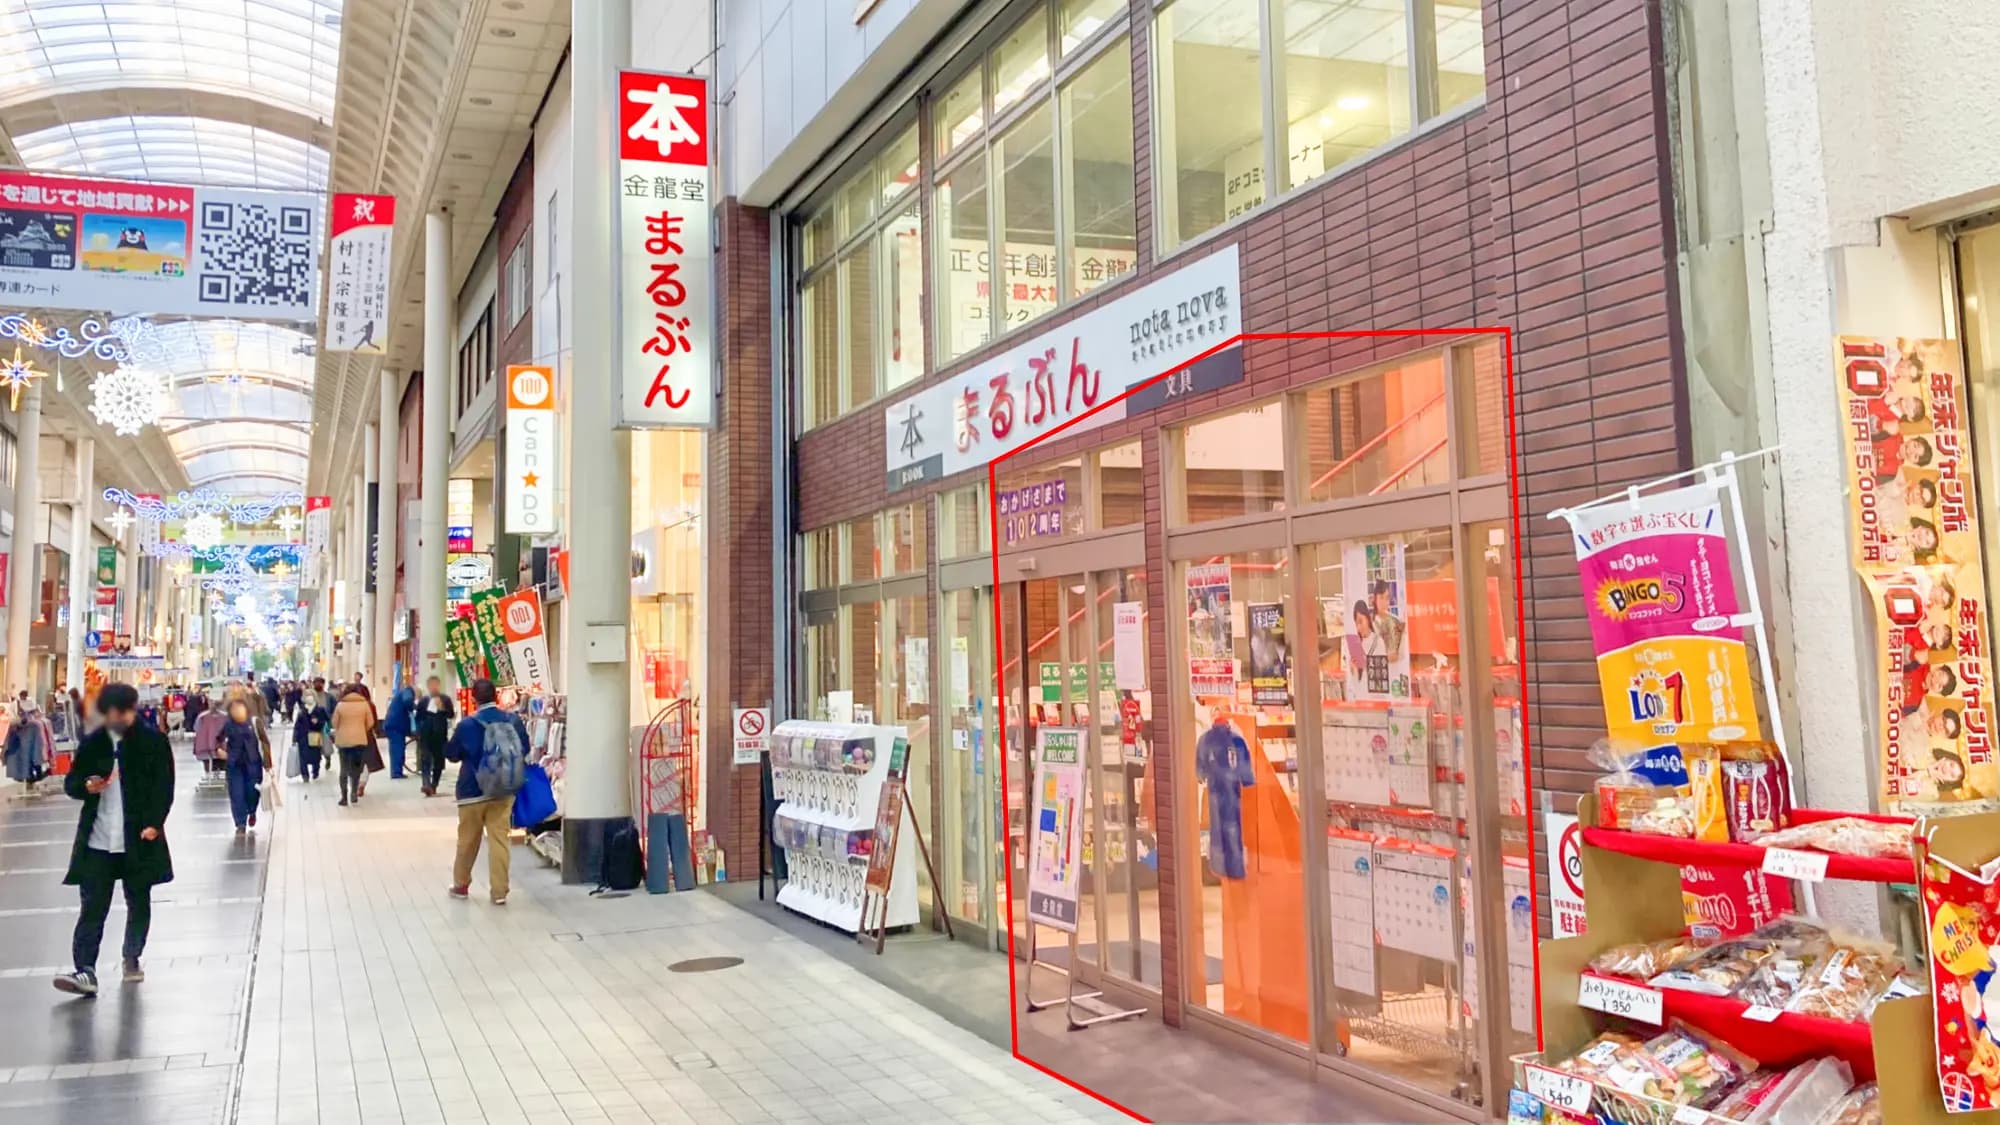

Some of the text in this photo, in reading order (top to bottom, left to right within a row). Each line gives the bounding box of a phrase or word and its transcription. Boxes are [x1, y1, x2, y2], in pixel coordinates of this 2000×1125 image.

[628, 83, 701, 157] 本
[0, 185, 154, 212] を通じて地域貢献
[353, 198, 374, 222] 祝
[624, 174, 705, 202] 金龍堂
[642, 210, 691, 409] まるぶん
[1130, 286, 1228, 343] nota nova
[1132, 315, 1228, 363] stationery
[955, 336, 1101, 453] まるぶん
[1165, 367, 1194, 398] 文具
[900, 404, 924, 460] 本
[1930, 372, 1969, 533] 年末ジャンボ
[522, 416, 539, 526] Can Do
[901, 465, 924, 485] BOOK
[1000, 483, 1065, 514] おかげさまで
[1007, 512, 1061, 542] 102周年
[1609, 582, 1660, 612] BINGO
[1958, 597, 1992, 765] 年末ジャンボ
